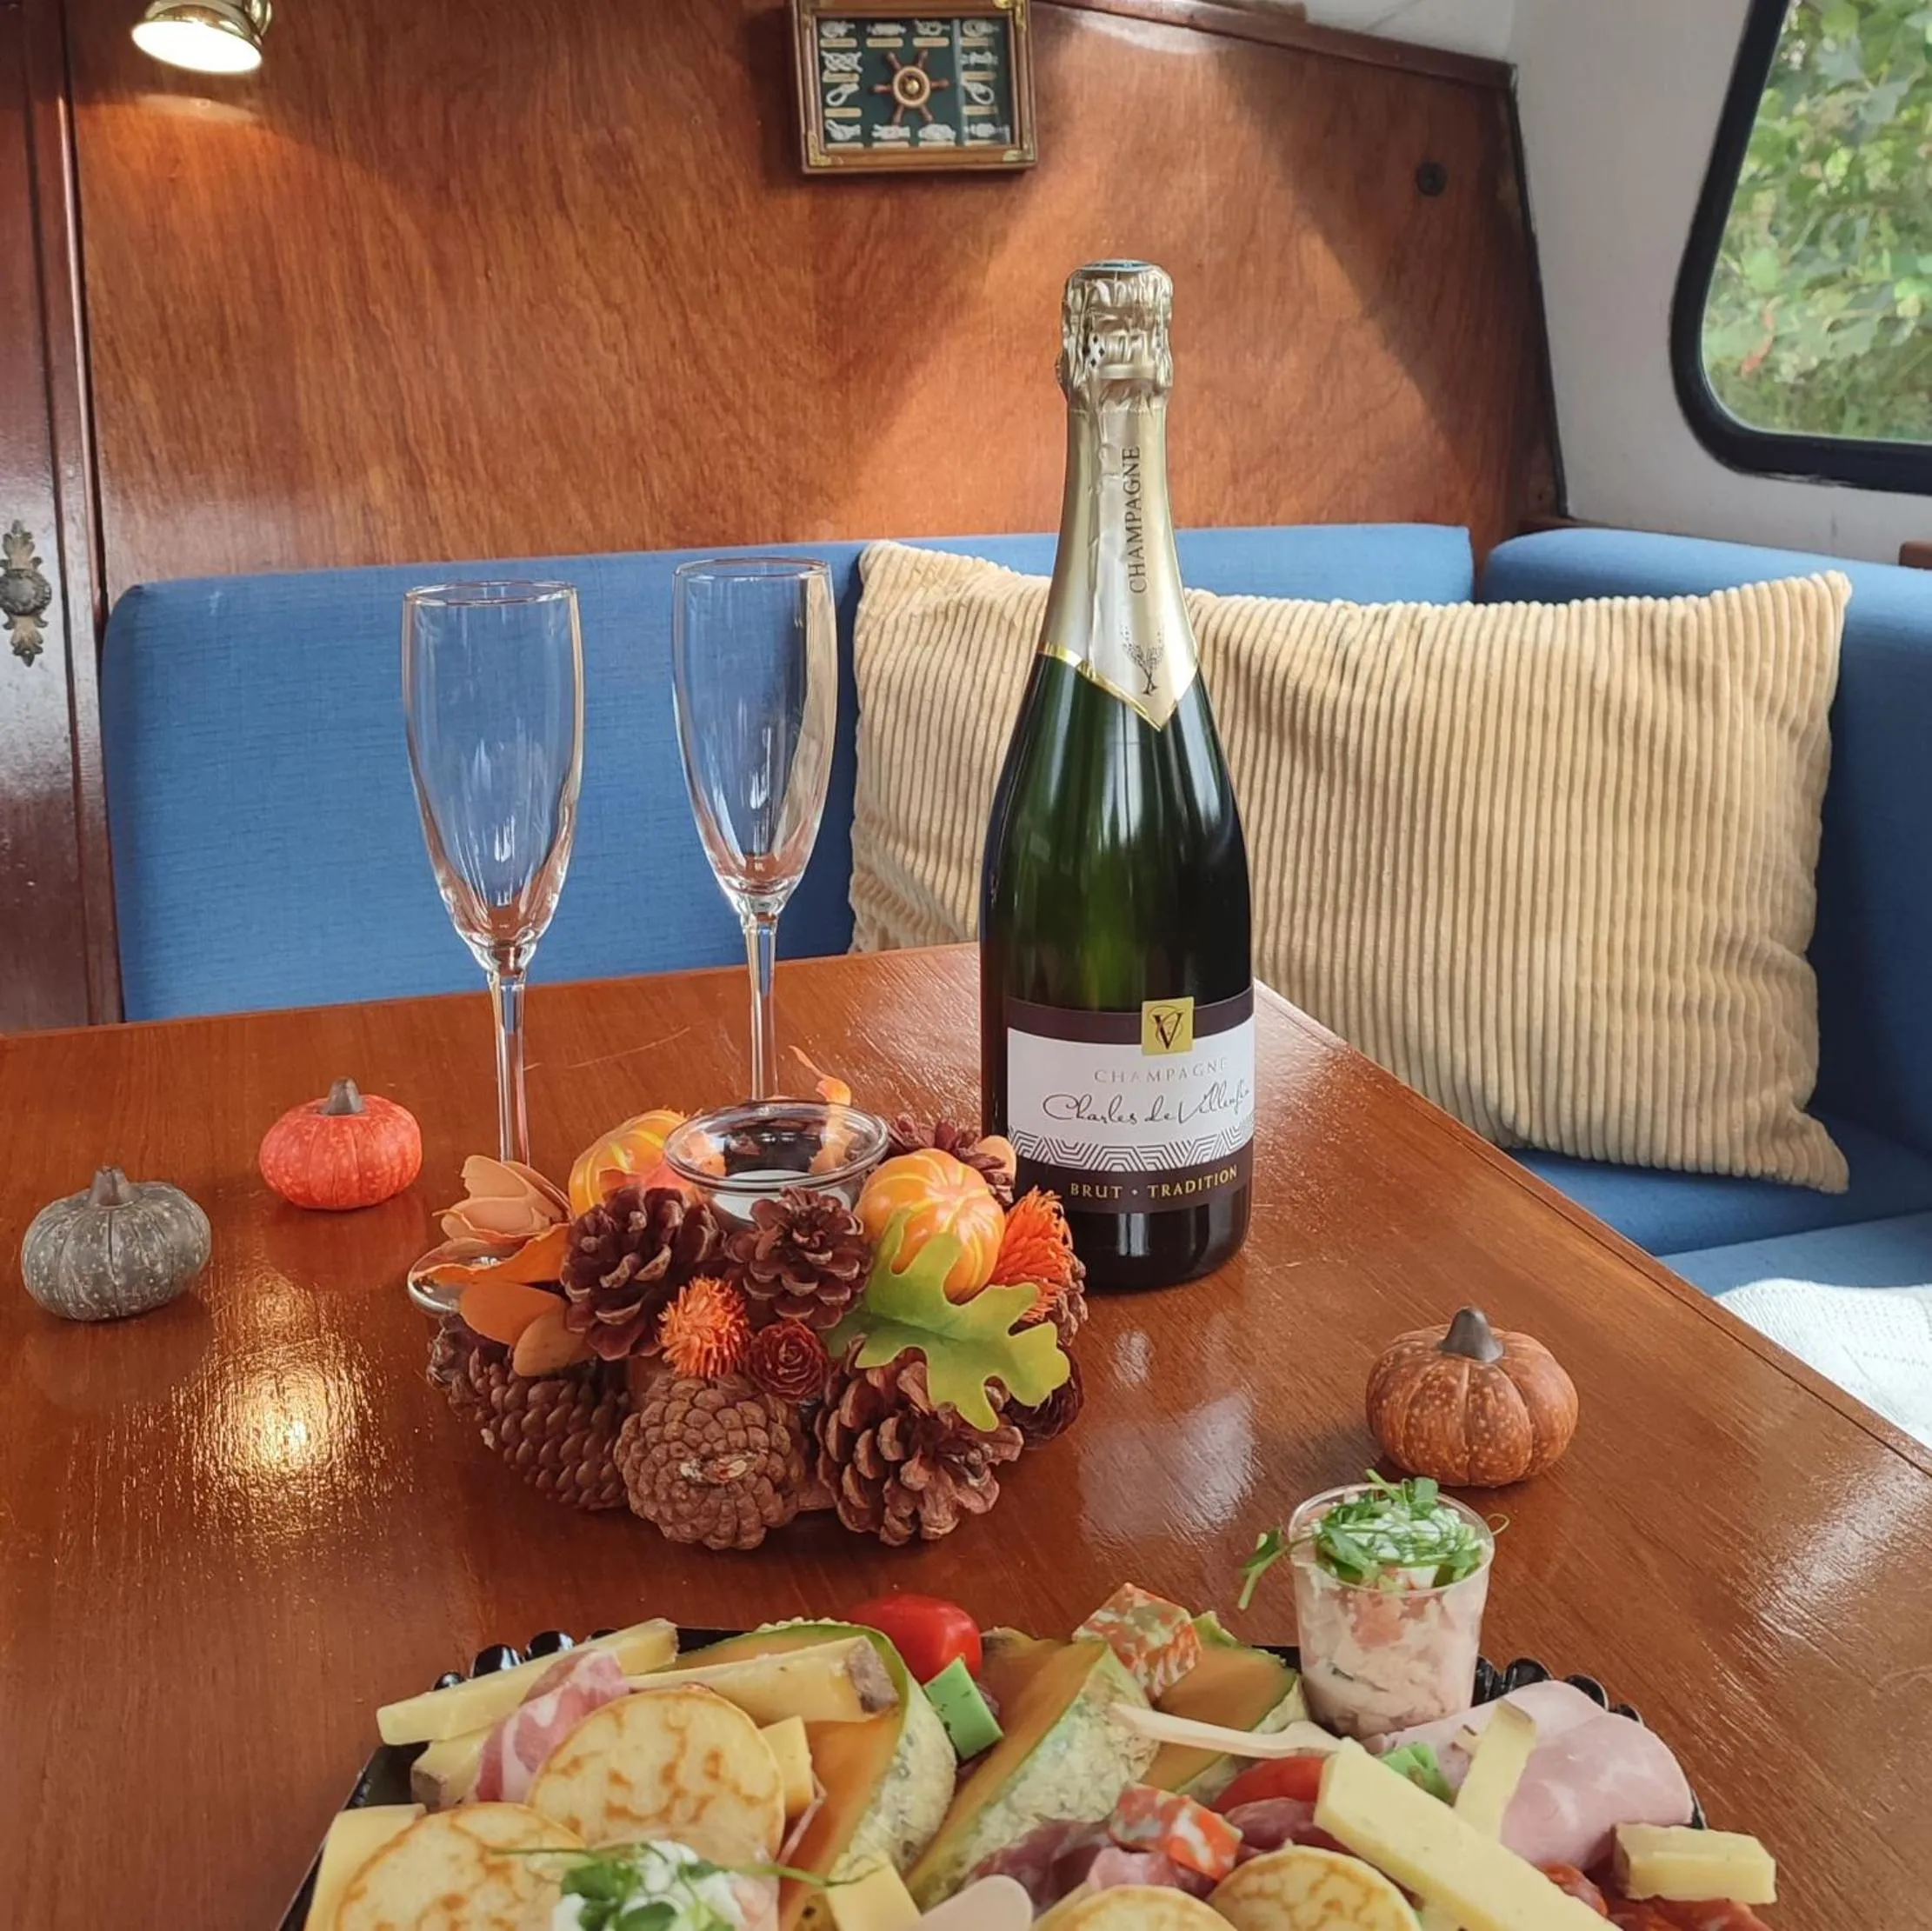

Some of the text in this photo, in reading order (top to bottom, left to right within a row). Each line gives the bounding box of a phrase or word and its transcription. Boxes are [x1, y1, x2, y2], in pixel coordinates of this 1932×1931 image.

[1123, 446, 1147, 593] CHAMPAGNE
[1043, 1094, 1137, 1125] Charles
[1144, 1095, 1176, 1122] de
[1070, 1165, 1238, 1200] BRUT TRADITION
